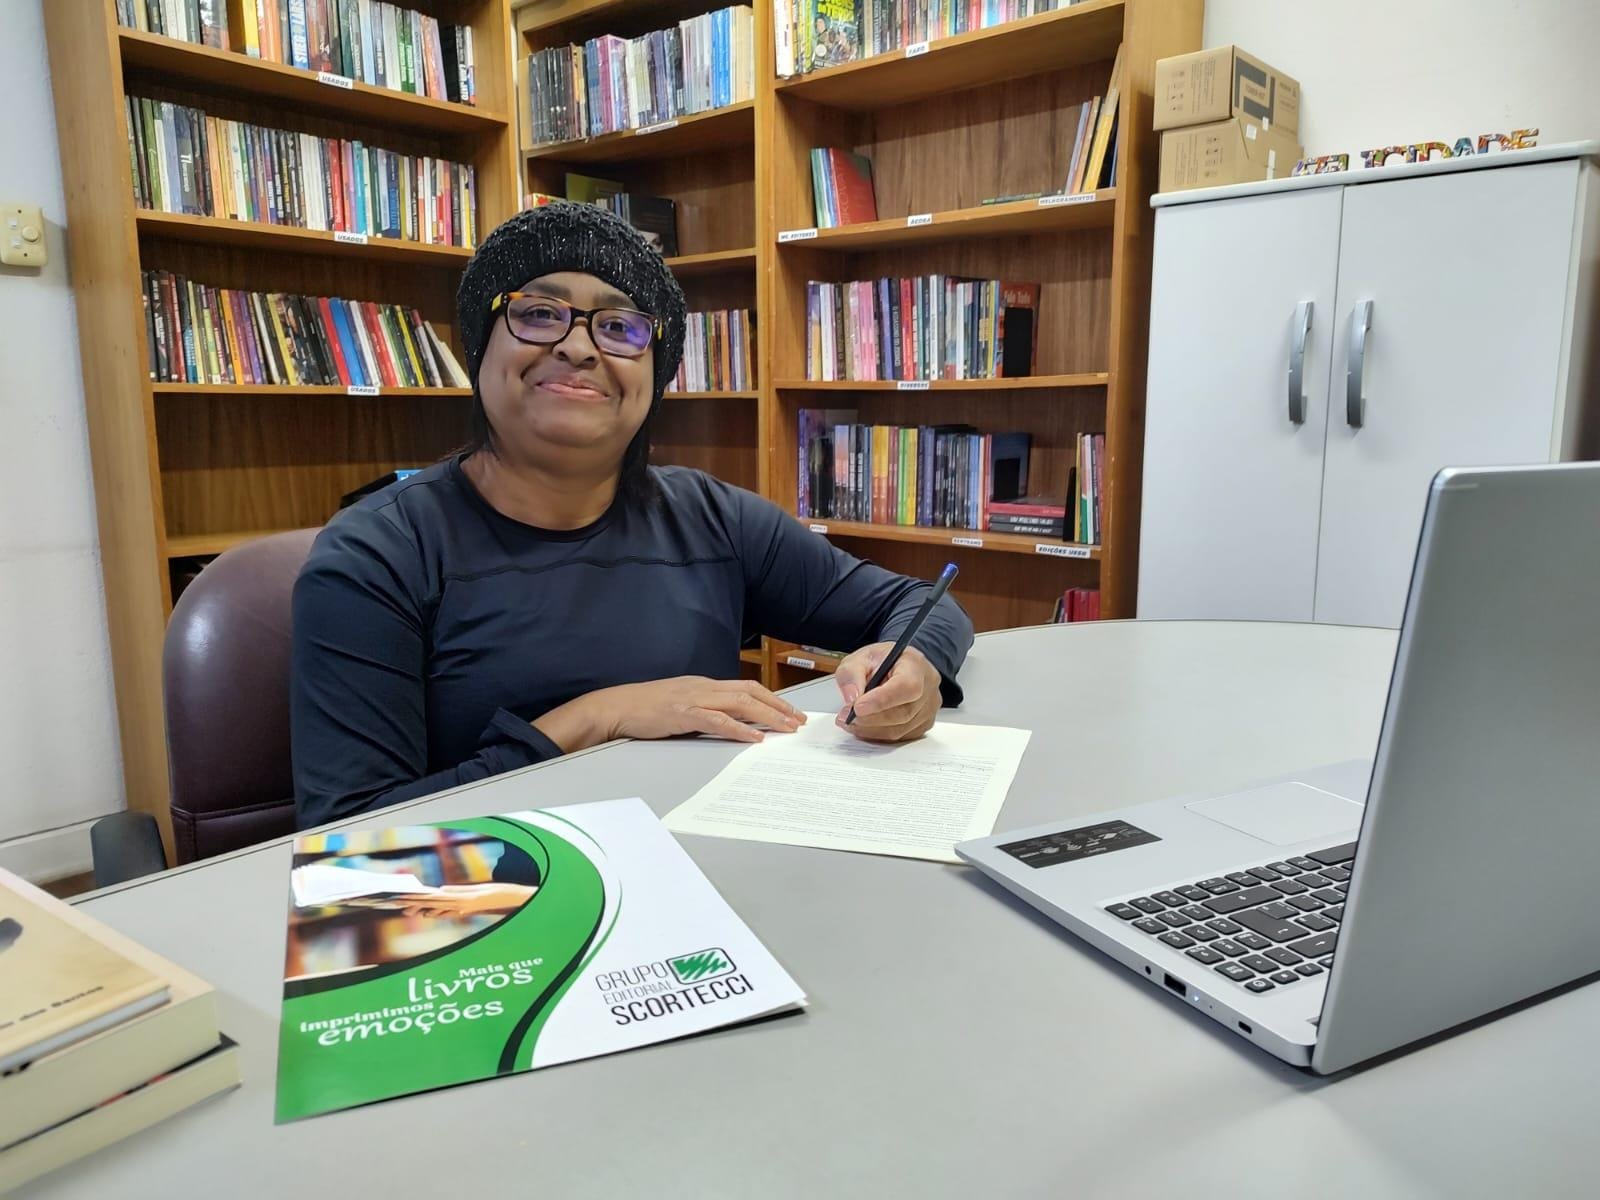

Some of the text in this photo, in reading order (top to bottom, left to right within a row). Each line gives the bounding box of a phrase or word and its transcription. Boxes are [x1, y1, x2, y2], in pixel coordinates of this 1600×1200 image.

[321, 75, 350, 87] USADOS
[337, 233, 364, 244] USADOS
[459, 957, 543, 979] Mais que
[595, 961, 669, 992] GRUPO
[408, 968, 534, 1003] livros
[602, 980, 674, 1005] EDITORIAL
[611, 974, 754, 1026] SCORTECCI
[300, 1002, 434, 1033] imprimimos
[318, 1001, 504, 1046] emoções
